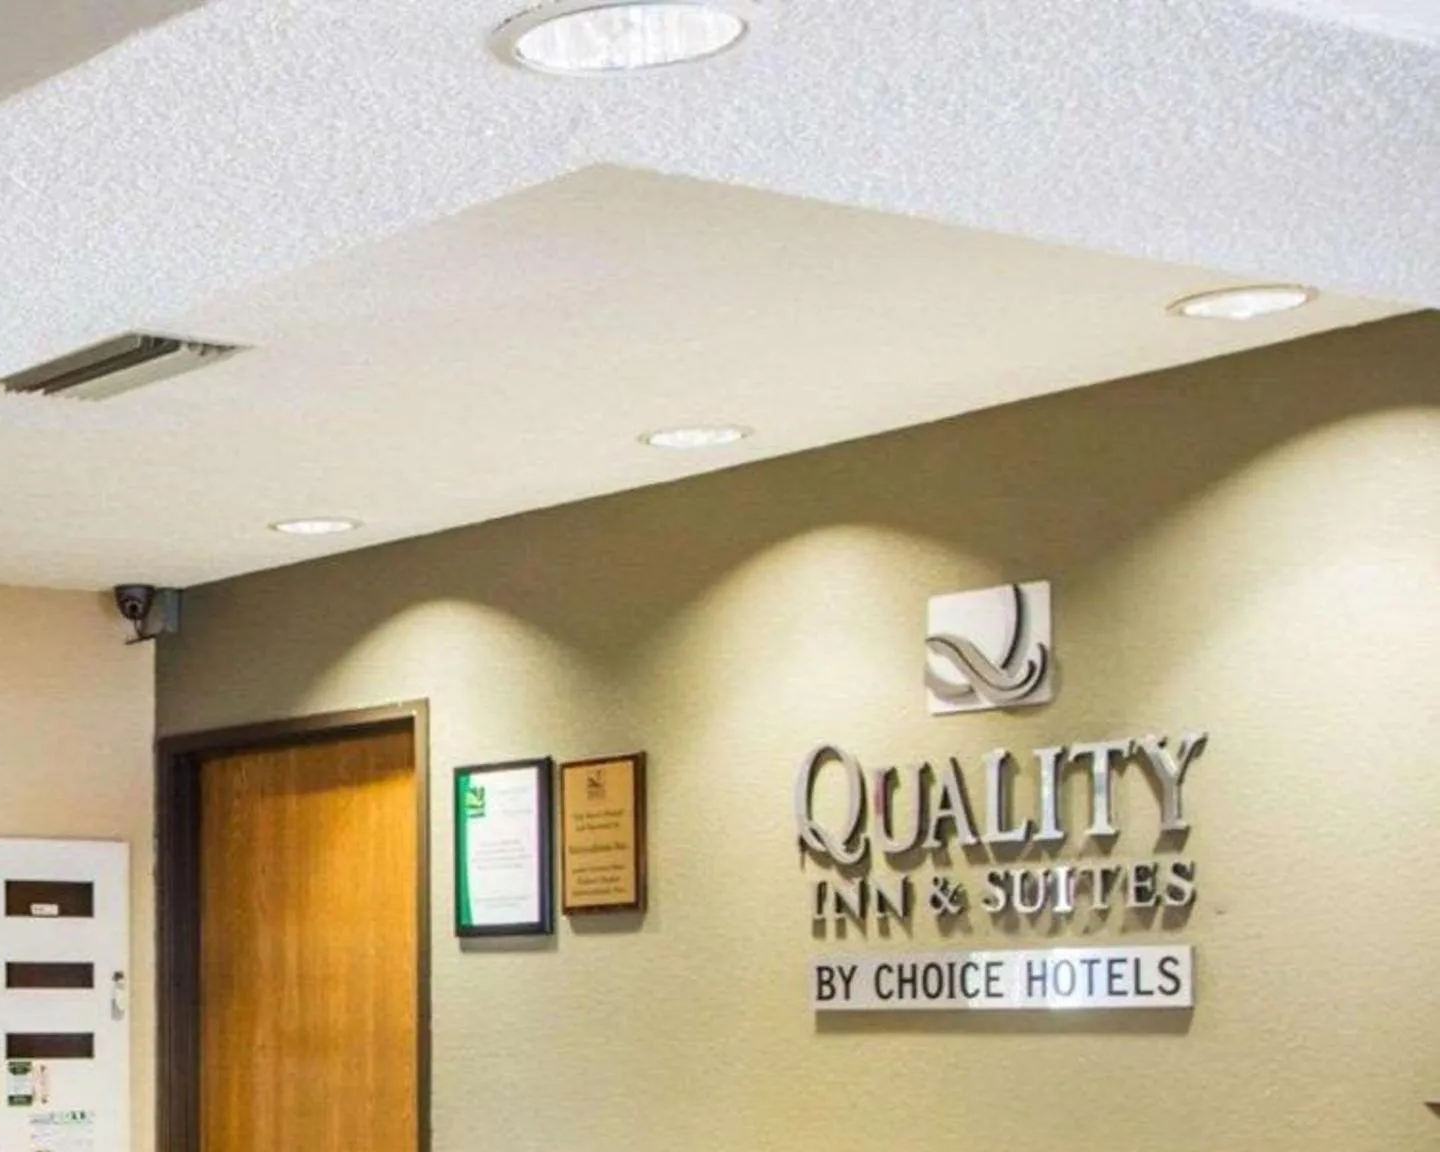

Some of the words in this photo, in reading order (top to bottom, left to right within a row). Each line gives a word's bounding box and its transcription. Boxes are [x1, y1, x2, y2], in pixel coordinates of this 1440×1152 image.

[795, 732, 1207, 864] QUALITY
[813, 876, 911, 921] INN
[929, 876, 963, 914] &
[982, 862, 1197, 914] SUITES
[815, 964, 859, 1001] BY
[874, 961, 1005, 1000] CHOICE
[1026, 956, 1183, 999] HOTELS
